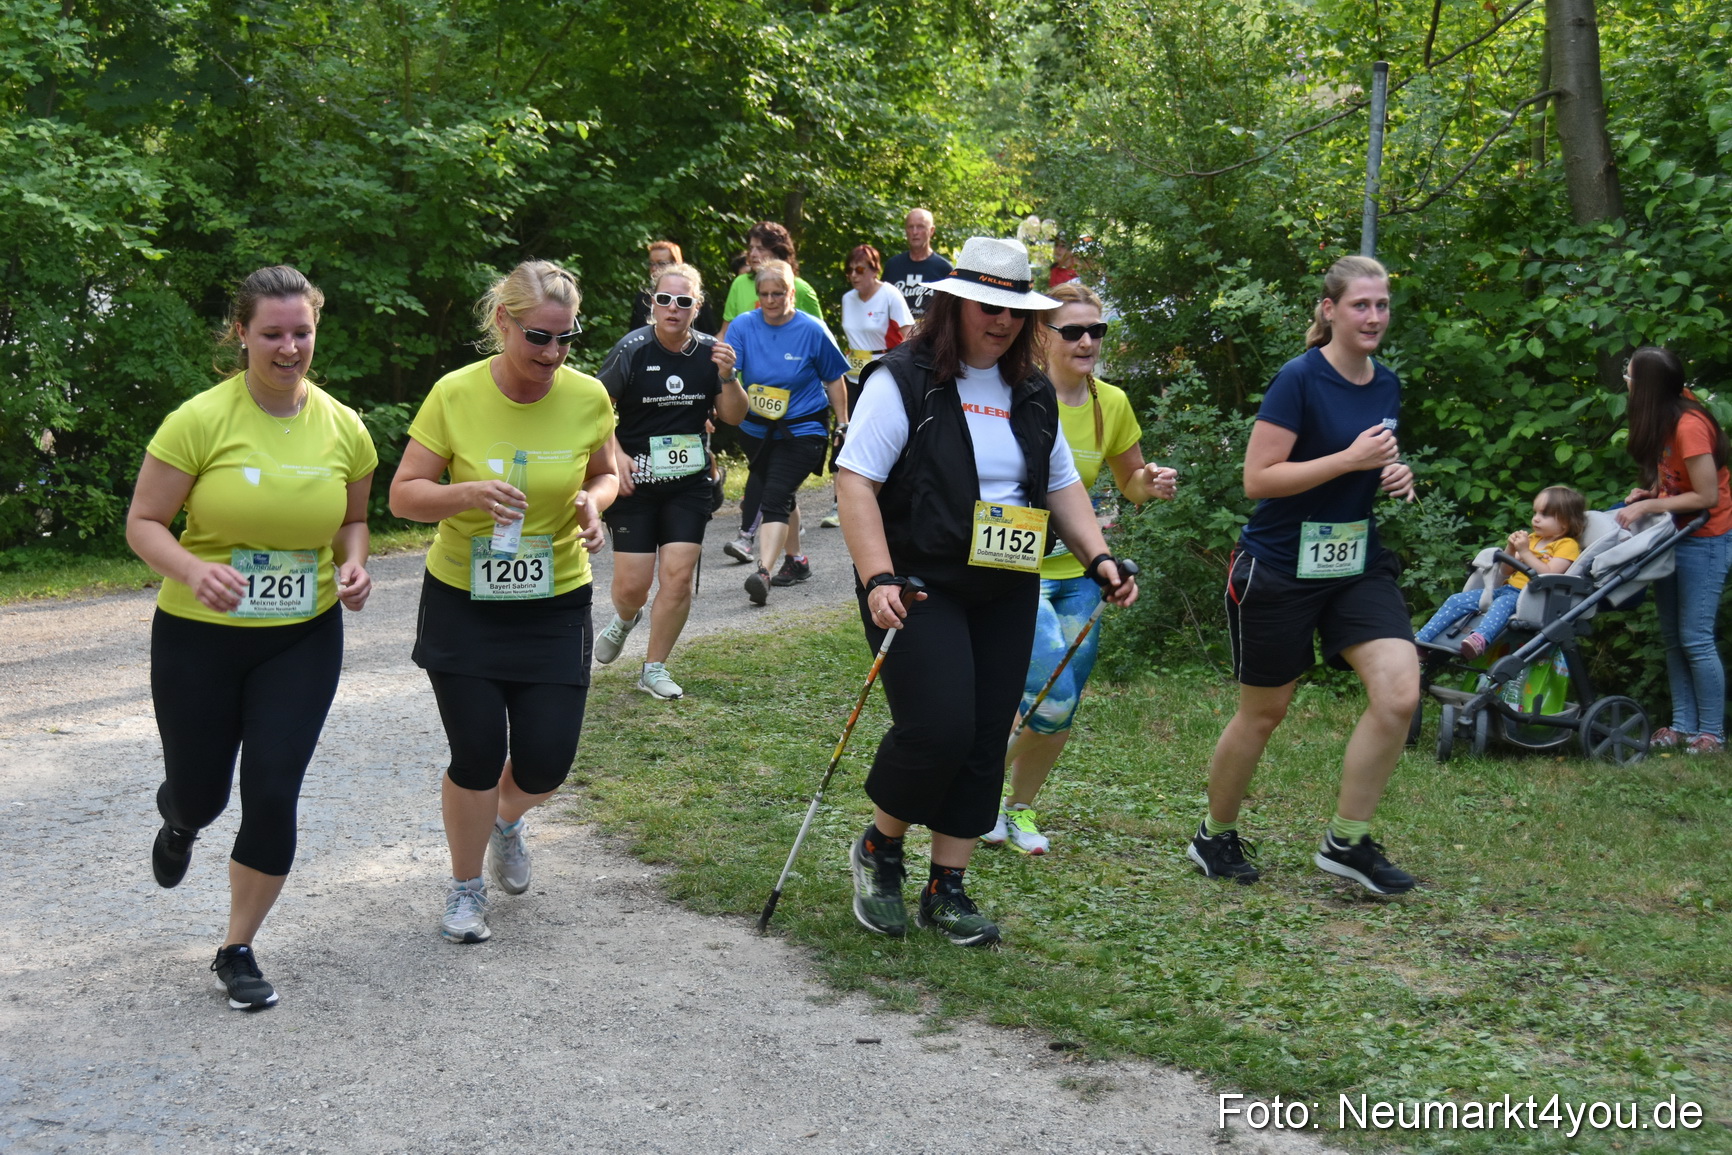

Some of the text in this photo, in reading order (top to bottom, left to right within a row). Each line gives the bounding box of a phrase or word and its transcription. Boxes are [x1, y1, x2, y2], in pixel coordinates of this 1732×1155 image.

[752, 396, 782, 411] 1066
[668, 449, 688, 465] 96
[983, 526, 1036, 554] 1152
[1004, 551, 1022, 559] Ingrid
[1021, 554, 1036, 562] Maria
[1310, 541, 1358, 562] 1381
[481, 559, 543, 582] 1203
[247, 574, 305, 598] 1261
